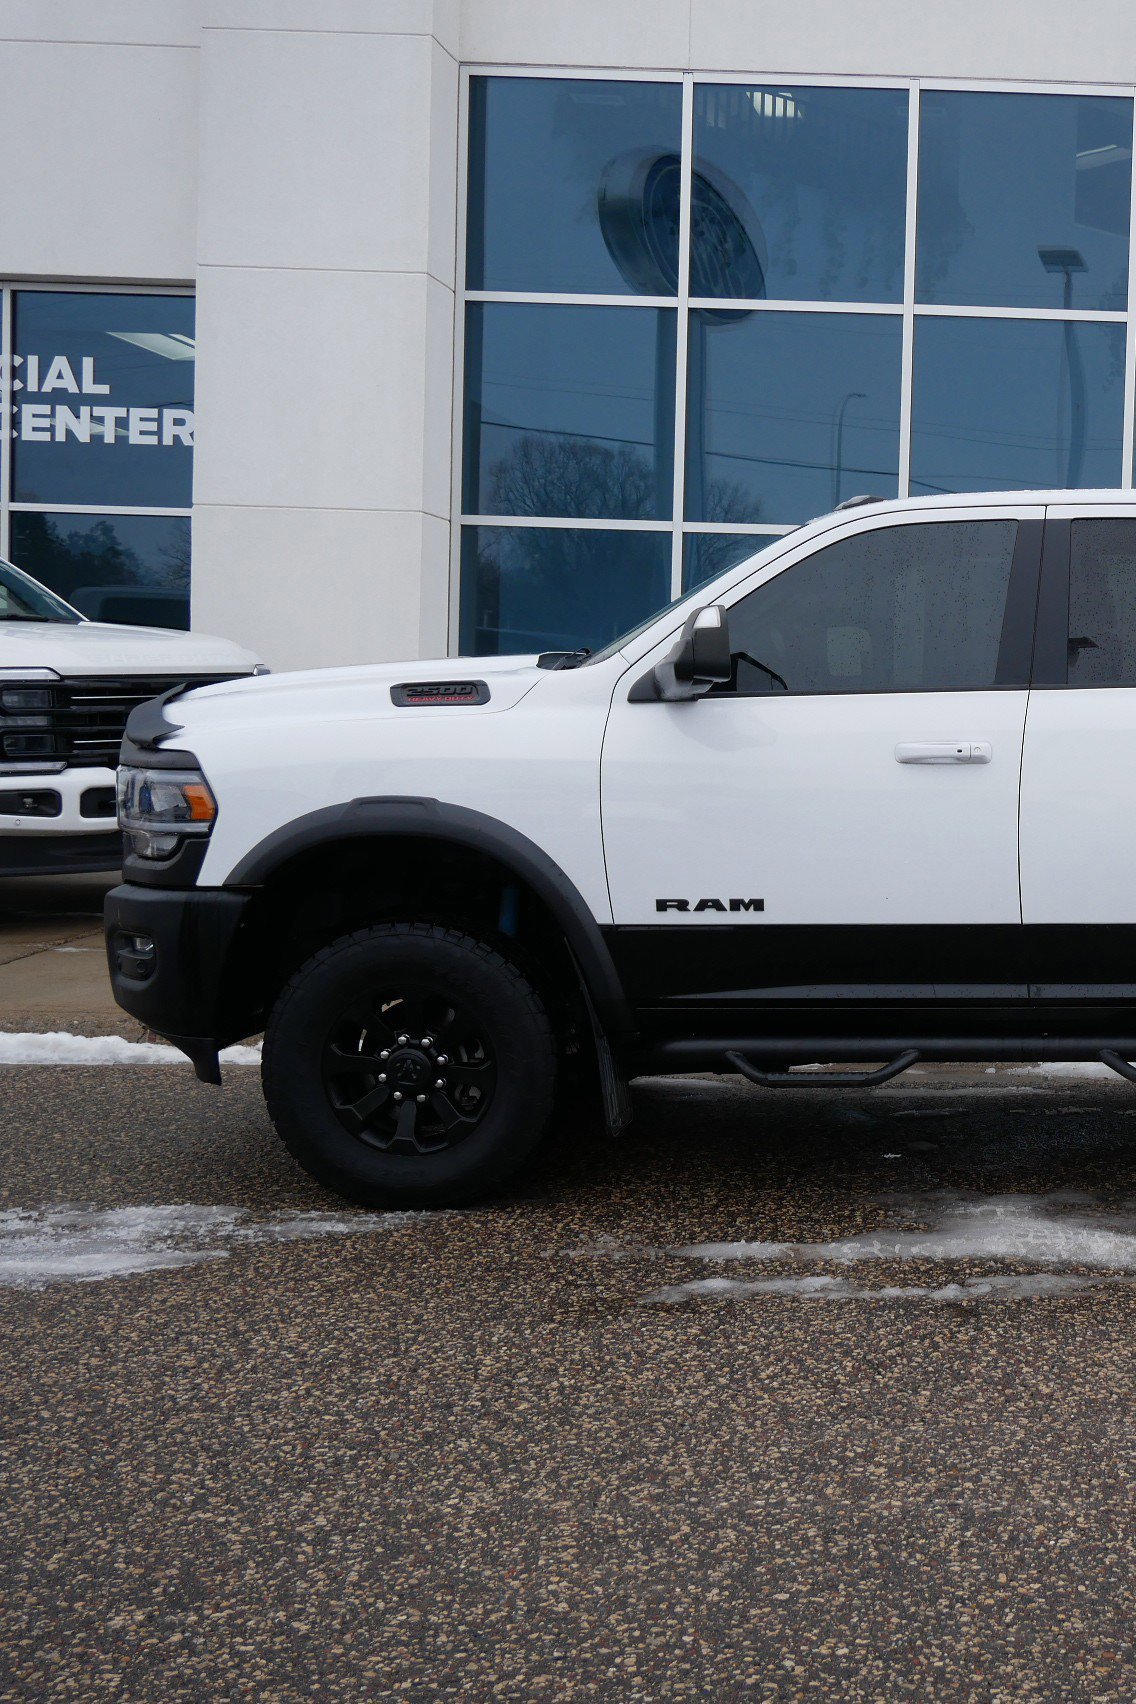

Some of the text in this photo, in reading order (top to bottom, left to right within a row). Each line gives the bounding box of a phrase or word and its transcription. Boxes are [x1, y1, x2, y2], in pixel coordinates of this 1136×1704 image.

[0, 403, 195, 447] ENTER
[407, 695, 442, 703] HEAVY
[656, 898, 765, 912] RAM
